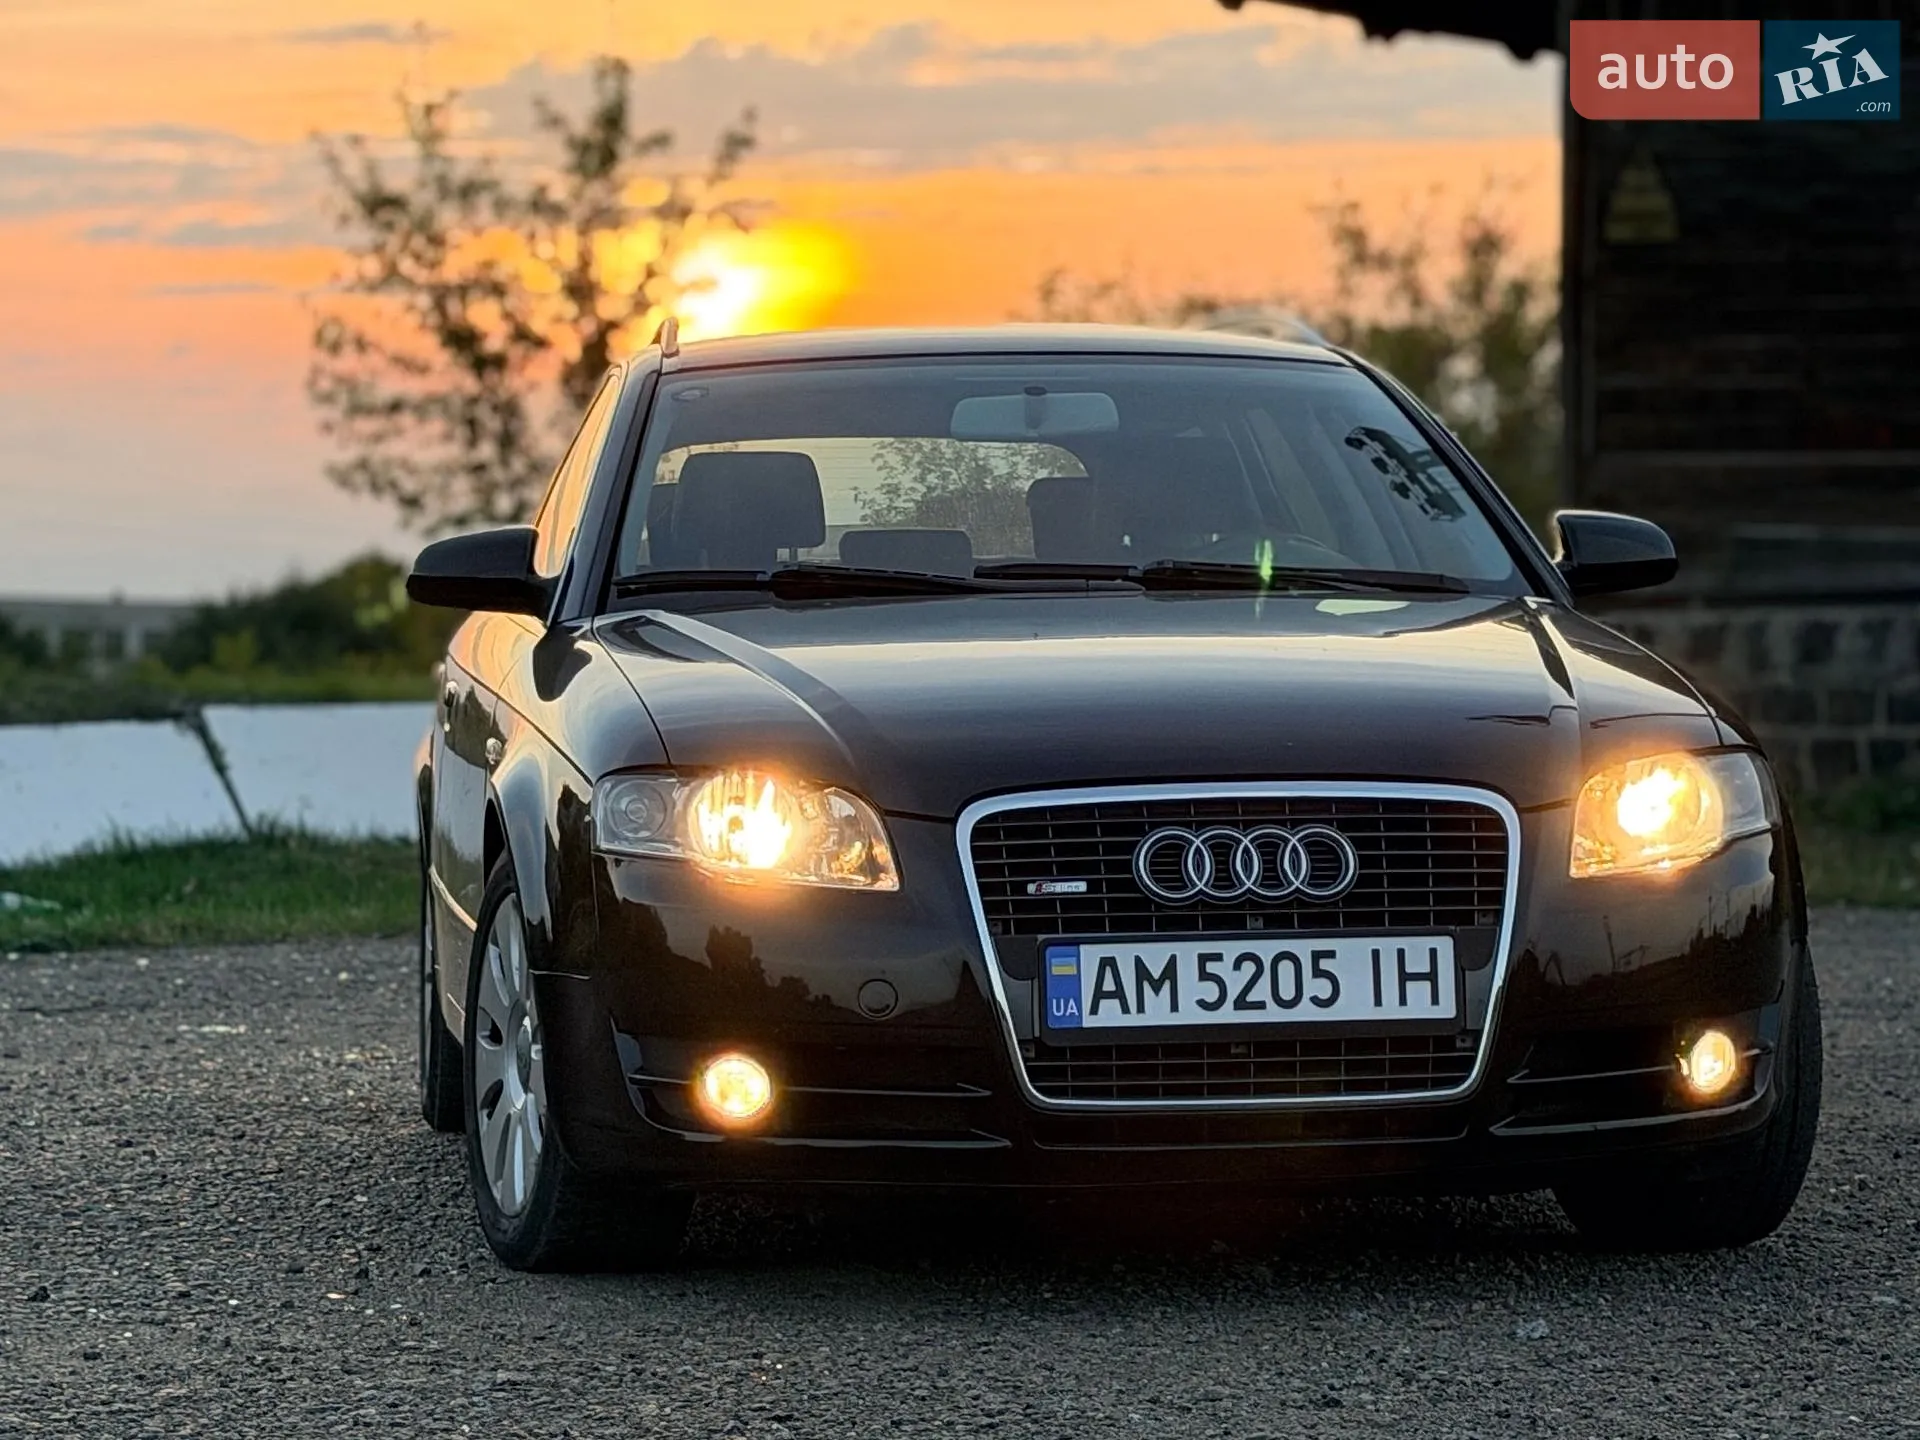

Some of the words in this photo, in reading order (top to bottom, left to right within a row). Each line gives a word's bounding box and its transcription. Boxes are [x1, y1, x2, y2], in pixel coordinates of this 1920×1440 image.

[1088, 953, 1180, 1016] AM
[1194, 949, 1341, 1012] 5205
[1371, 946, 1441, 1008] IH
[1052, 997, 1080, 1017] UA
